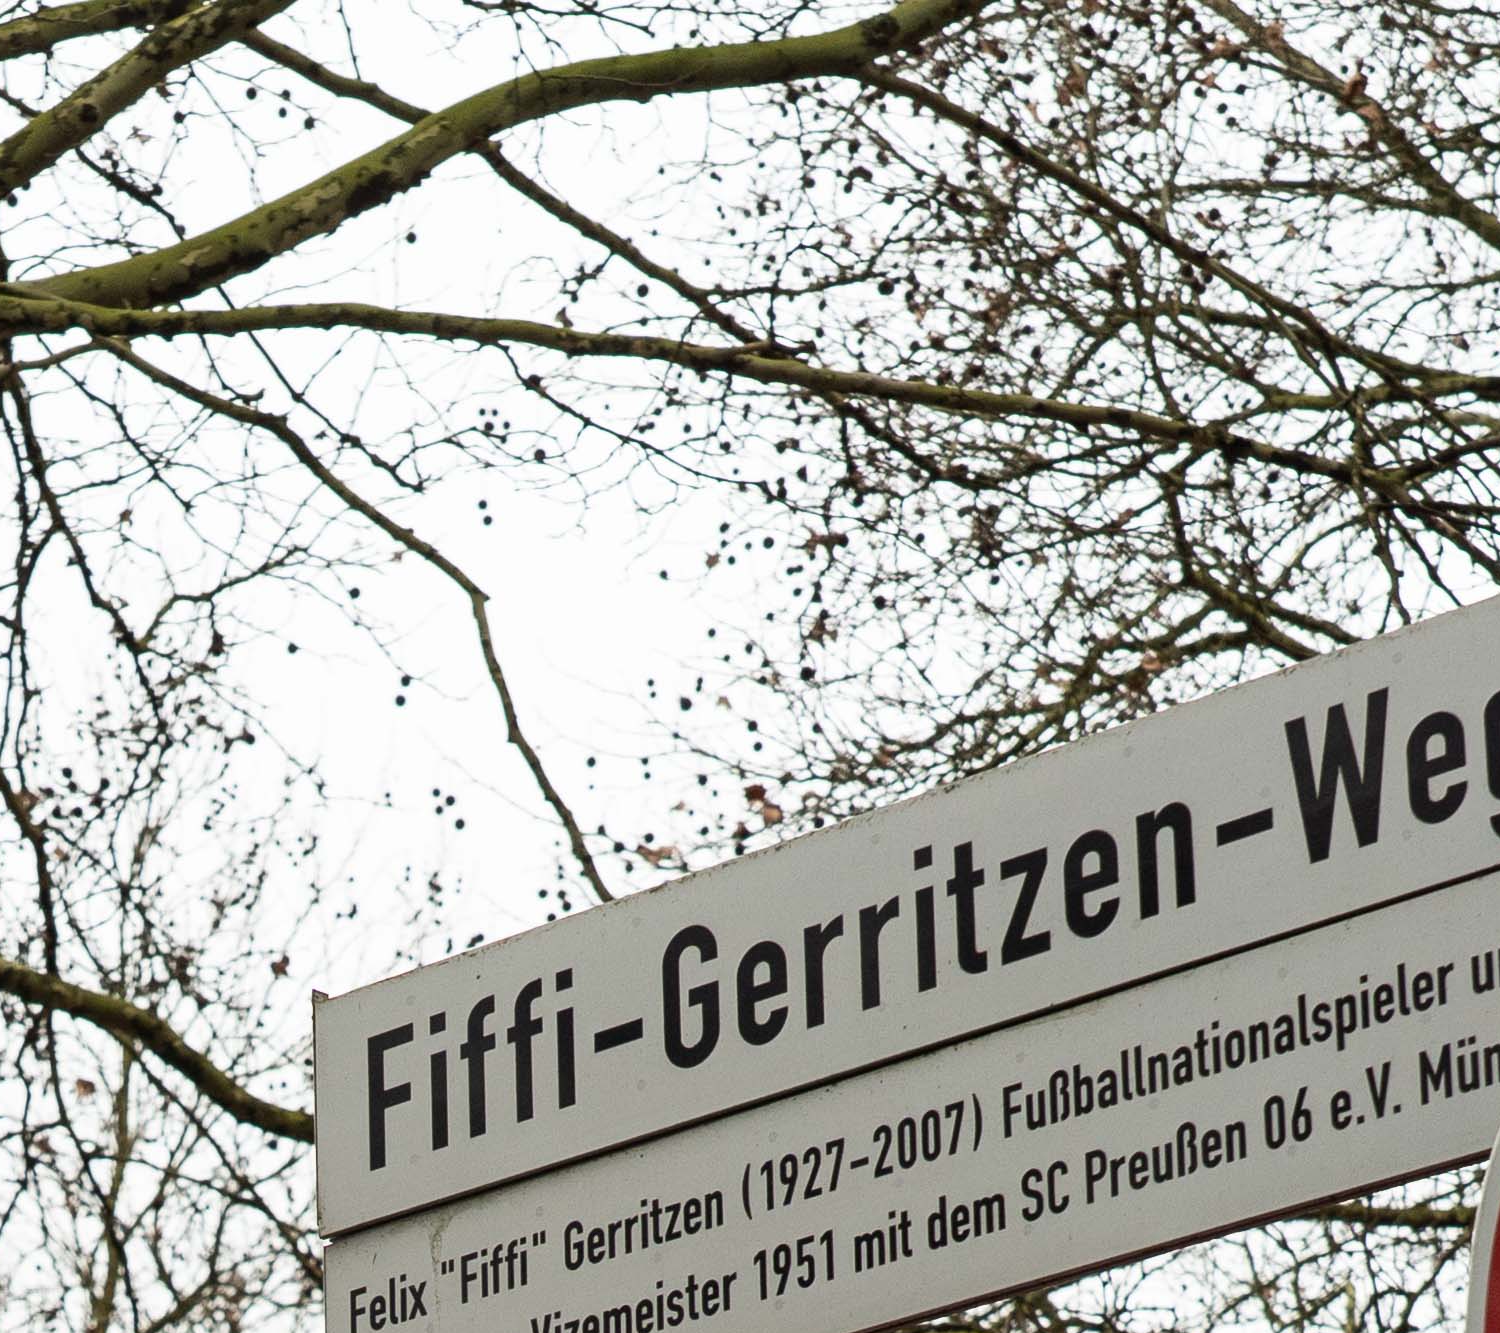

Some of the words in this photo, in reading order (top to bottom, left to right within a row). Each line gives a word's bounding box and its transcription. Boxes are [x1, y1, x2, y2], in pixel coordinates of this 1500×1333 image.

[440, 1229, 547, 1305] "Fiffi"
[563, 1190, 724, 1271] Gerritzen
[741, 1092, 983, 1221] (1927-2007)
[1002, 962, 1455, 1139] Fußballnationalspieler
[753, 1229, 835, 1301] 1951
[853, 1209, 913, 1274] mit
[927, 1193, 1007, 1251] dem
[1020, 1160, 1070, 1223] SC
[1084, 1120, 1247, 1205] Preußen
[1263, 1085, 1313, 1150] 06
[1330, 1060, 1402, 1131] e.V.
